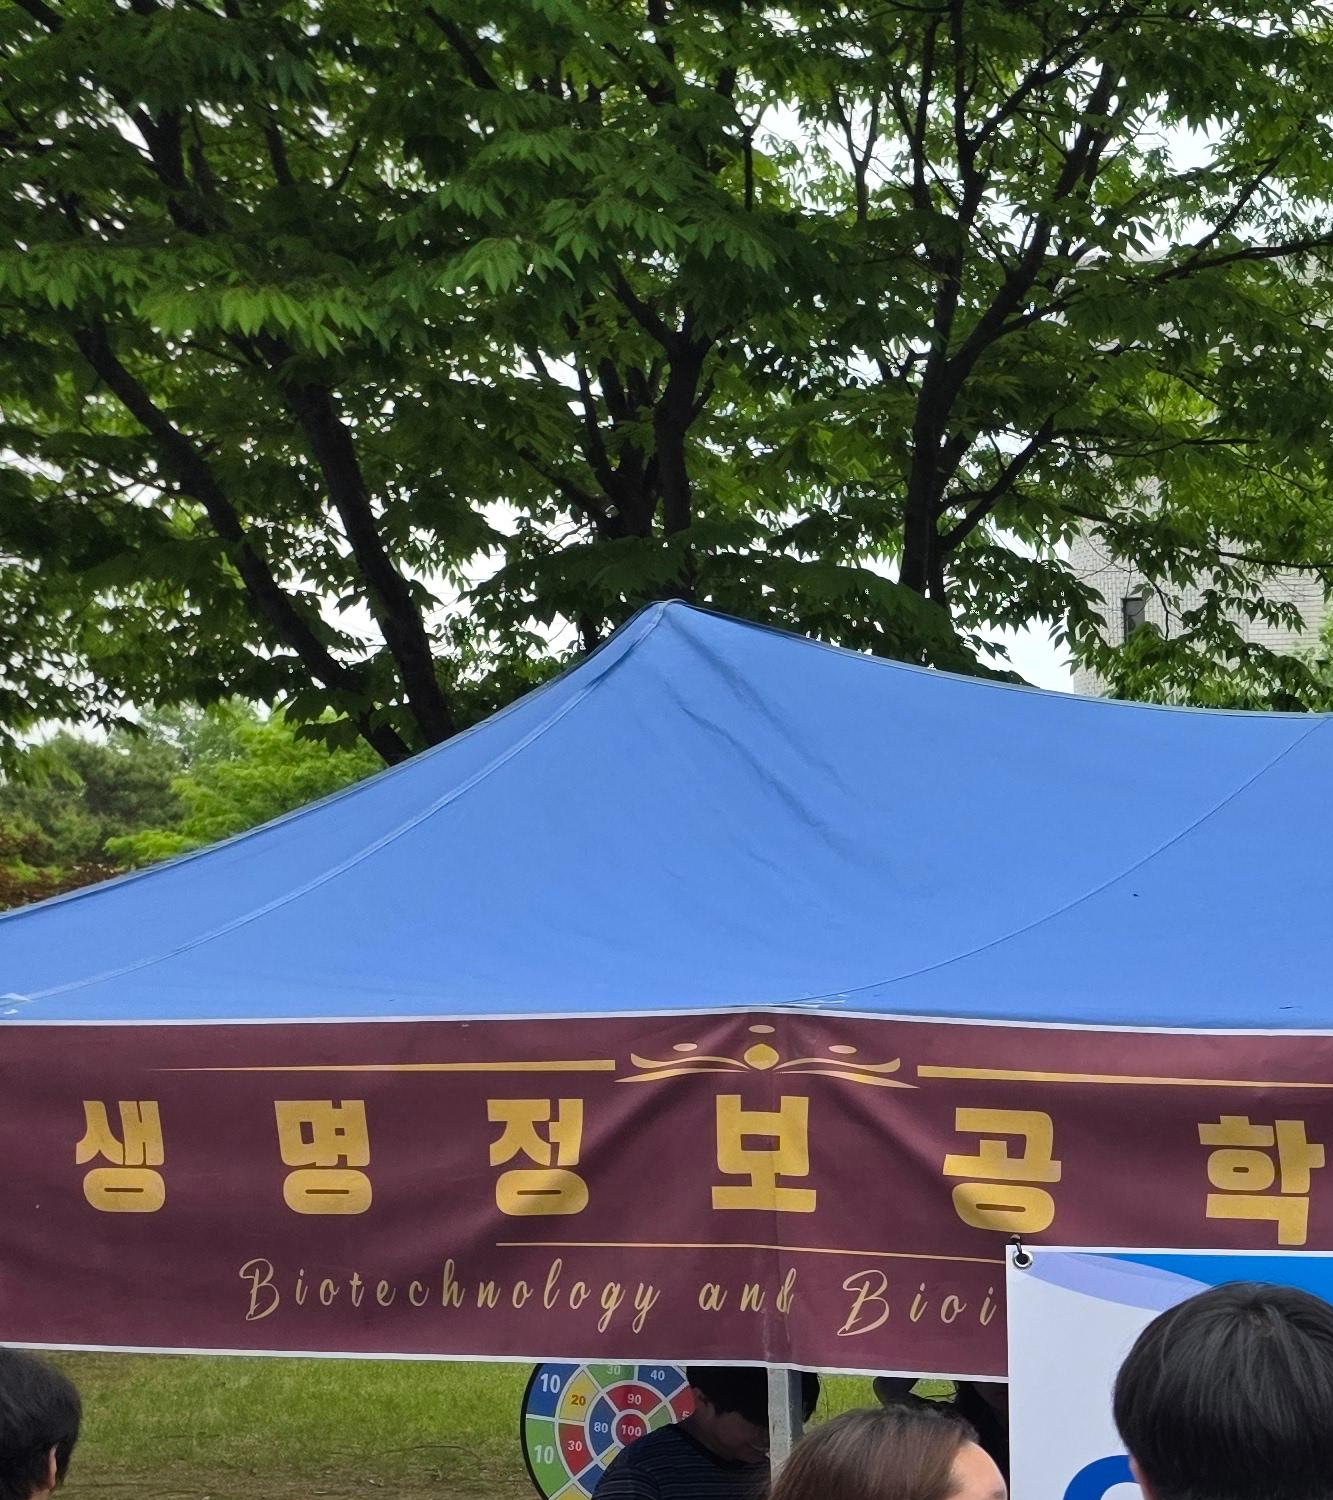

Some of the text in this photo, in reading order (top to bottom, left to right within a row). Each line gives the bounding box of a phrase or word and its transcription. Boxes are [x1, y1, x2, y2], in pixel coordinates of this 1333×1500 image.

[239, 1258, 661, 1334] Biotechnology
[698, 1268, 796, 1314] and
[650, 1369, 665, 1381] 40
[540, 1374, 561, 1393] 10
[571, 1394, 586, 1406] 20
[627, 1394, 642, 1405] 90
[594, 1422, 608, 1433] 80
[621, 1424, 642, 1436] 100
[568, 1440, 583, 1451] 30
[534, 1445, 554, 1464] 10
